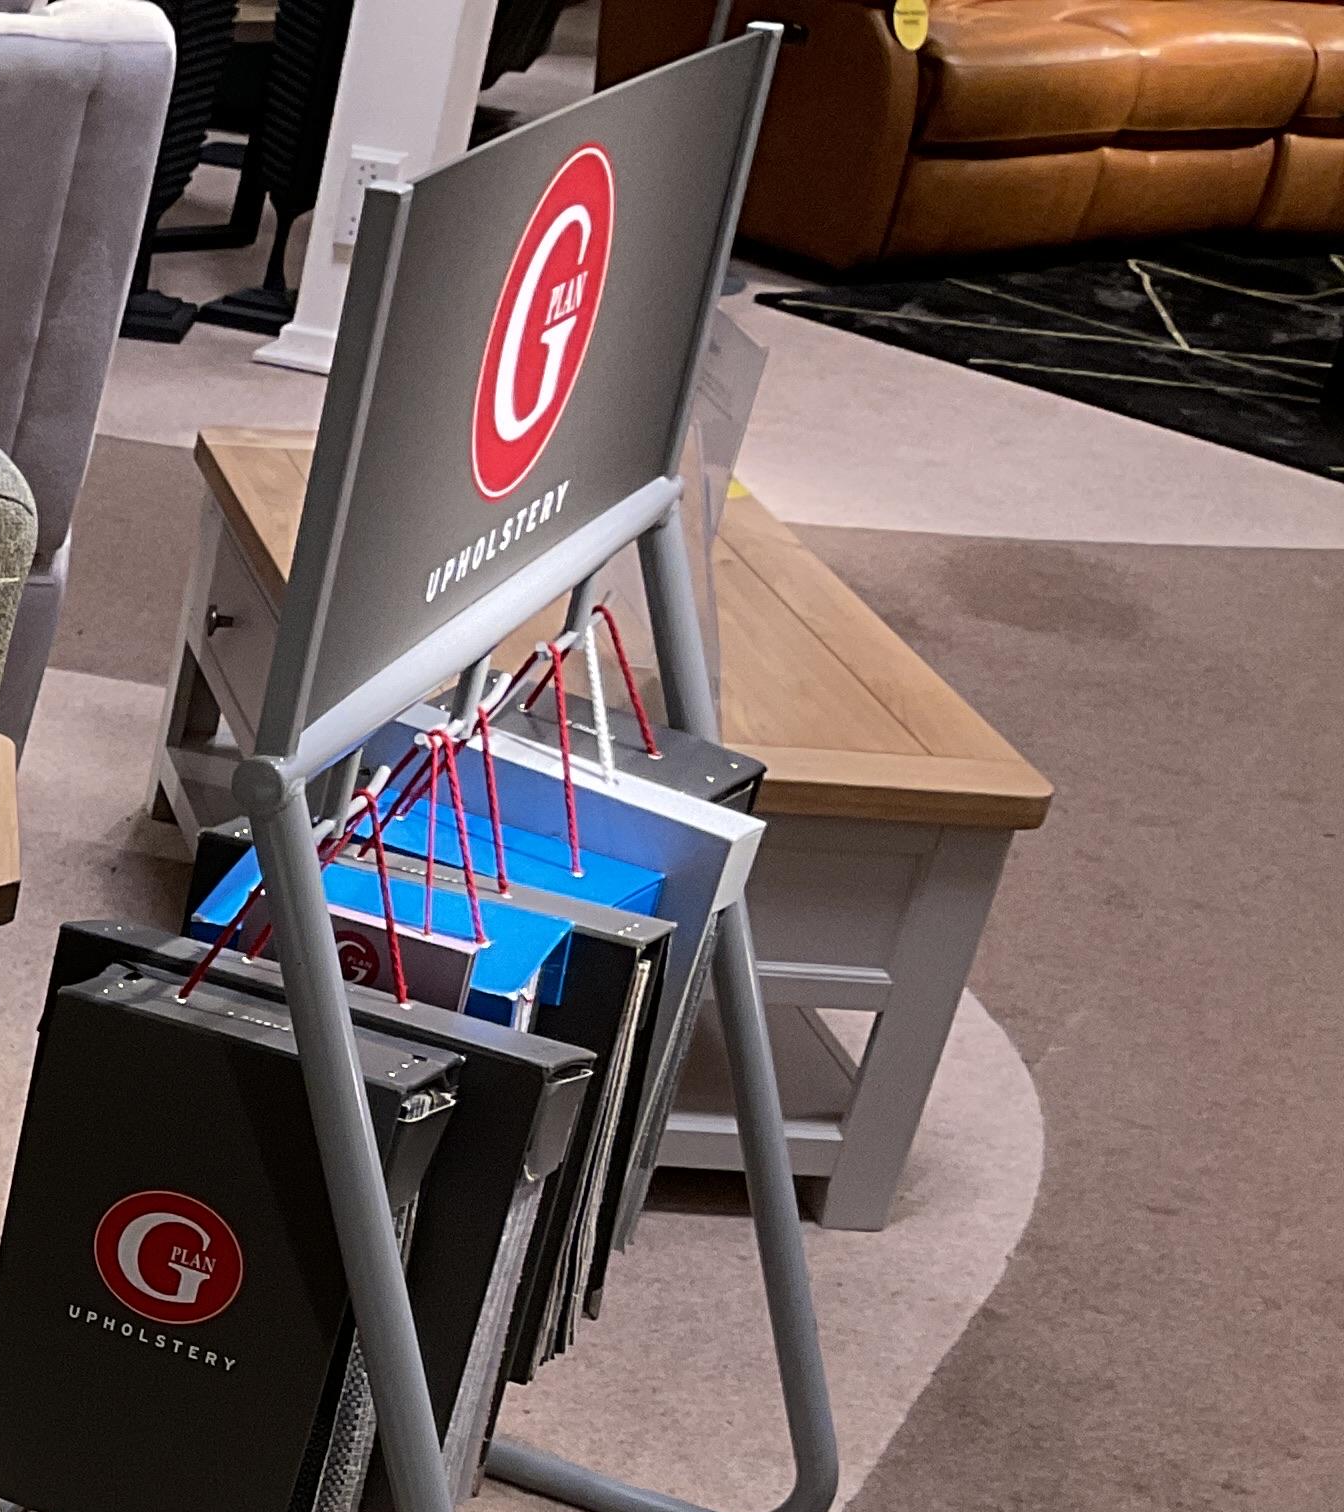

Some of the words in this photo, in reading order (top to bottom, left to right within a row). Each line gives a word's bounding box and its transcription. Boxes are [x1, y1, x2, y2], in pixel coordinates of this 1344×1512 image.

[493, 203, 592, 443] G
[544, 270, 589, 326] PLAN
[424, 479, 571, 604] UPHOLSTERY
[117, 1212, 212, 1304] G
[170, 1246, 217, 1274] PLAN
[68, 1304, 236, 1372] UPHOLSTERY
